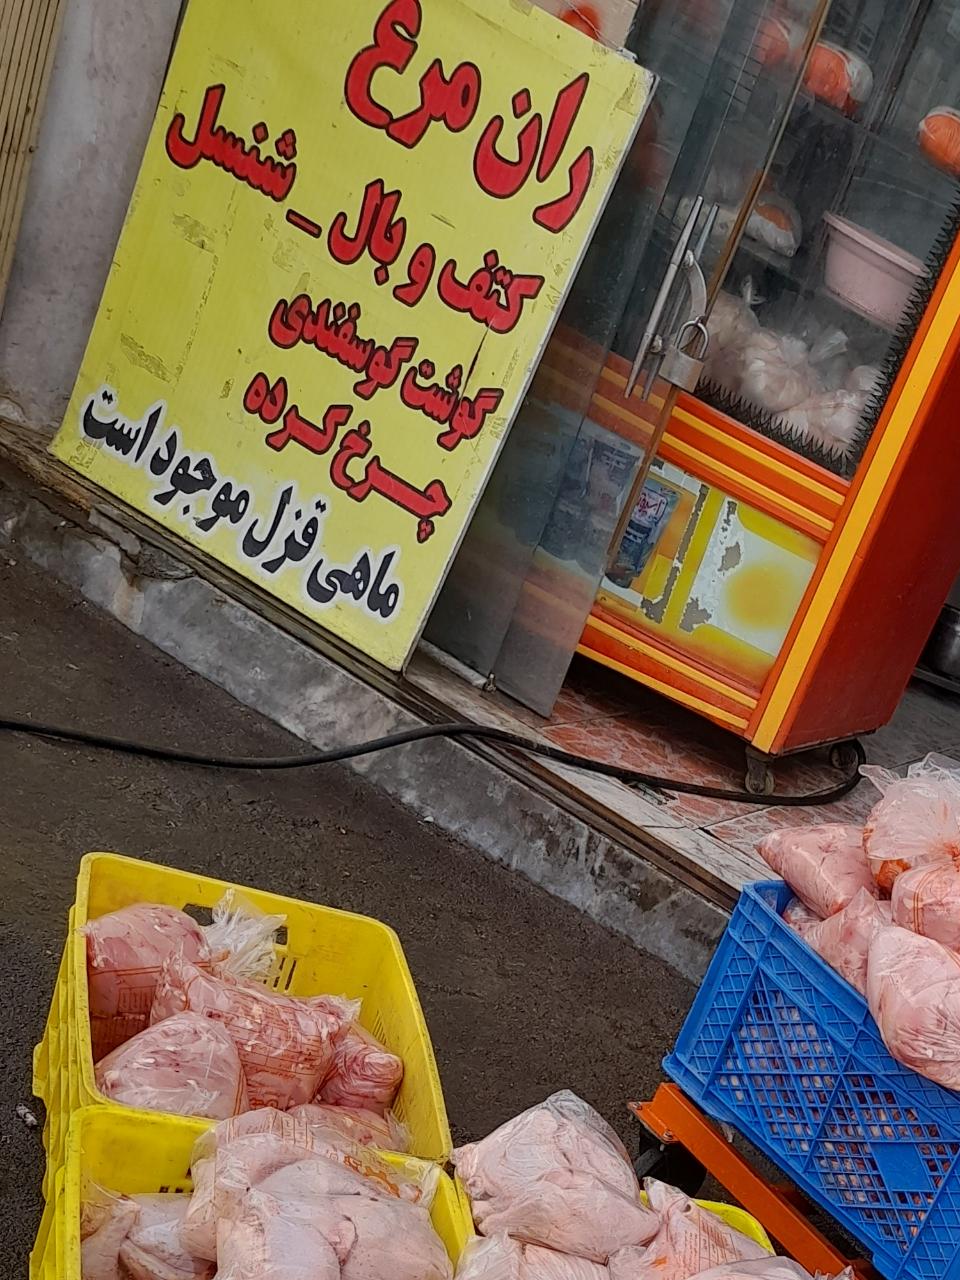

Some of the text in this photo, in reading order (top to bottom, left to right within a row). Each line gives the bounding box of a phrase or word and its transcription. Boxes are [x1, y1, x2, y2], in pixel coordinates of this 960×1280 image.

[165, 84, 297, 202] شنسل
[473, 72, 595, 234] ران
[327, 178, 406, 286] بال
[393, 243, 436, 307] و
[437, 250, 545, 334] کتف
[243, 372, 353, 455] کرده
[268, 294, 504, 452] گوشت گوسفندی
[83, 390, 400, 618] ماهی قزل موجود است
